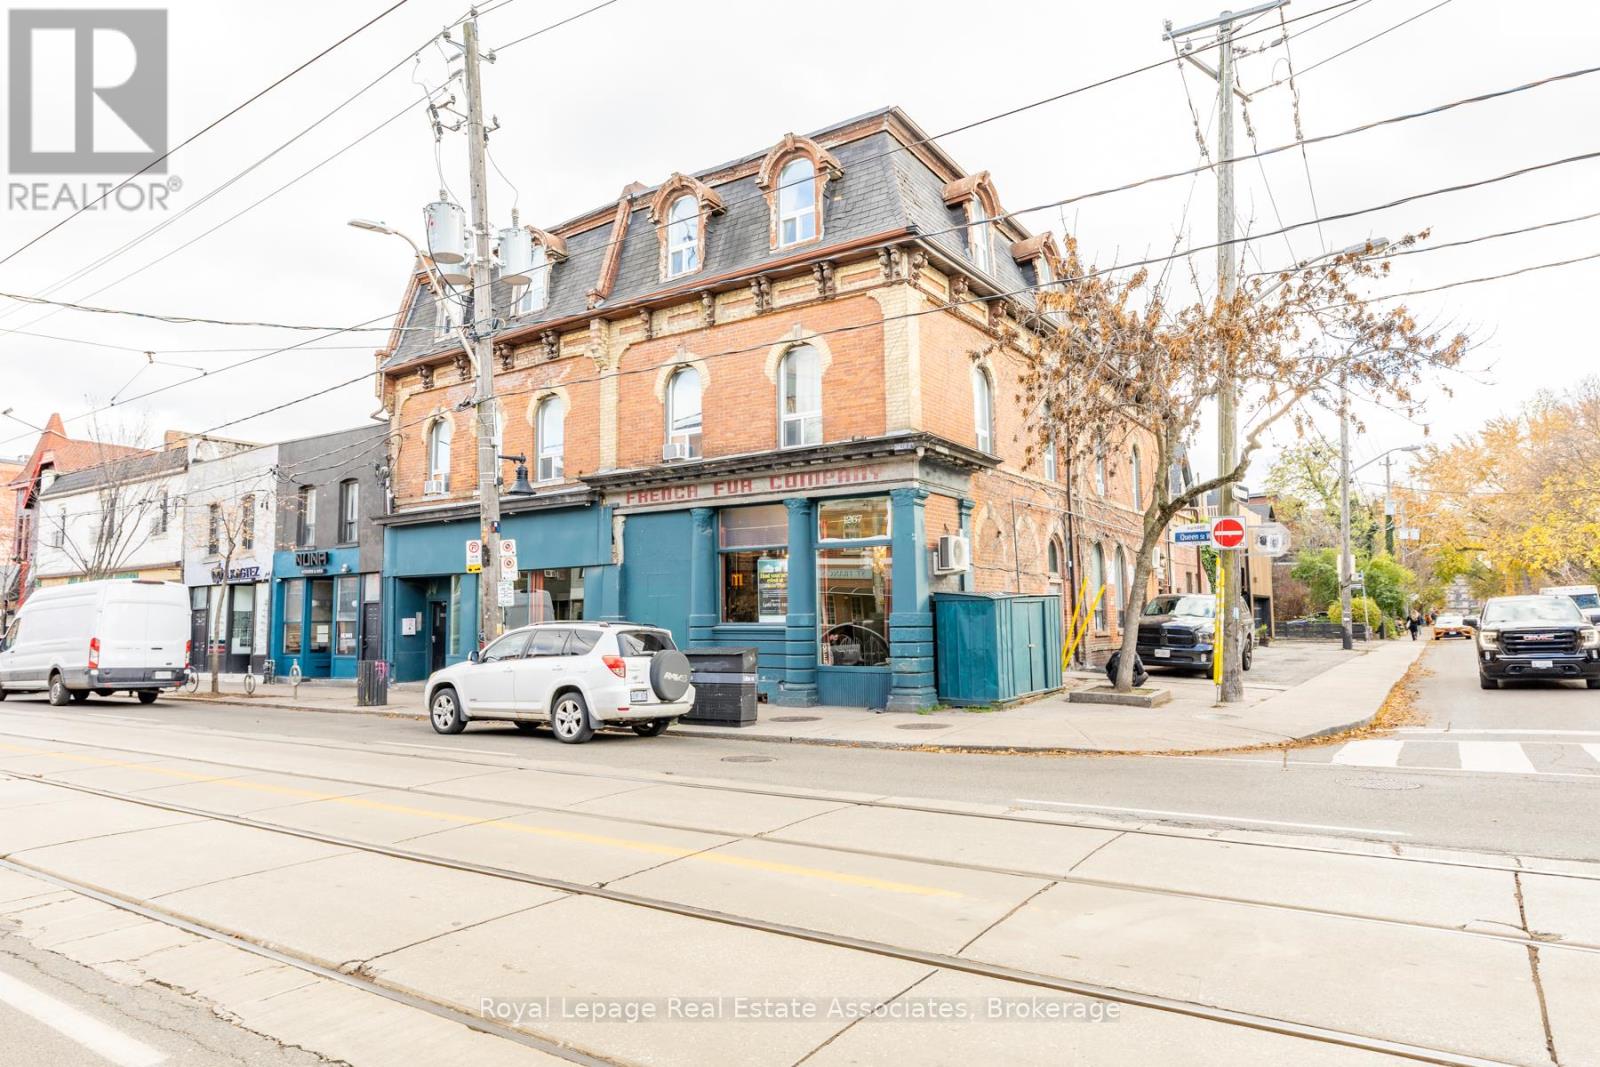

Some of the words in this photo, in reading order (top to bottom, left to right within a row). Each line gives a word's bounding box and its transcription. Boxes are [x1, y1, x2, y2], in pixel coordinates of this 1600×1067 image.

[626, 484, 698, 504] FRENCH
[713, 480, 752, 496] FUR
[769, 464, 882, 490] COMPANY
[1180, 533, 1199, 541] Queen
